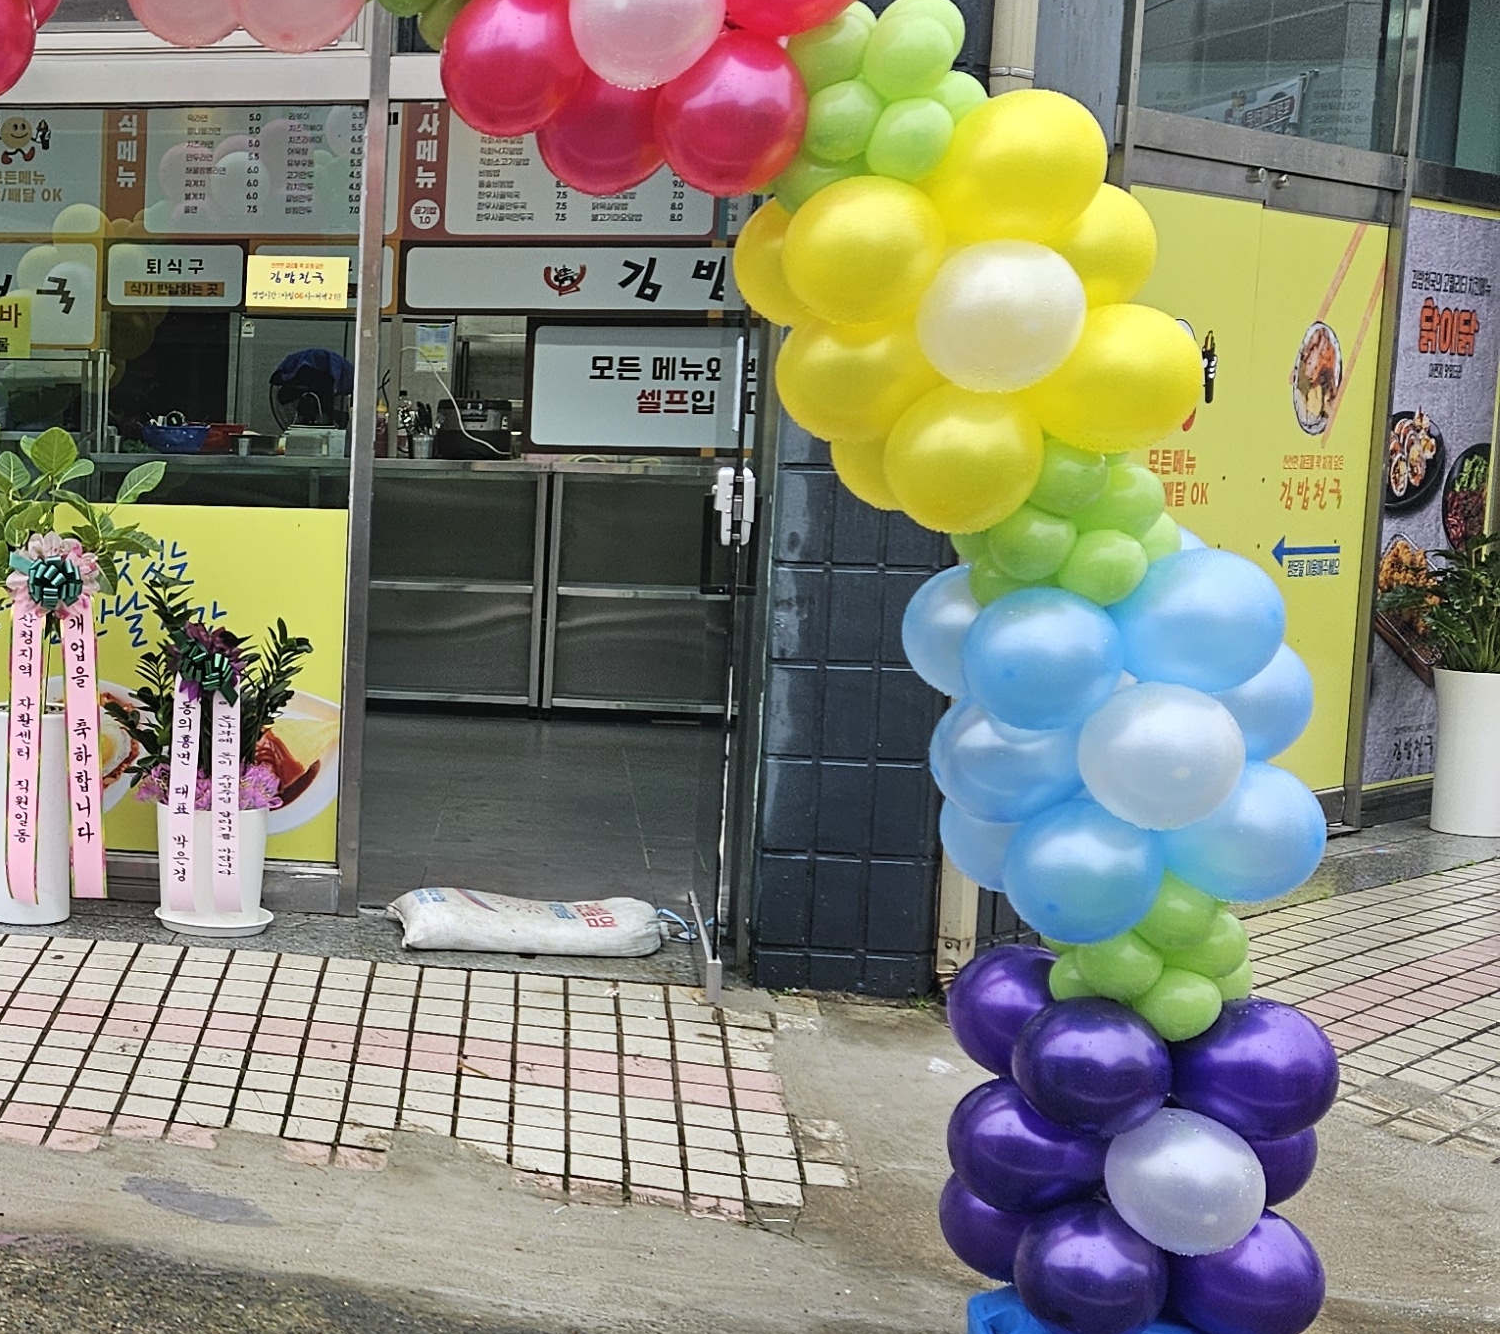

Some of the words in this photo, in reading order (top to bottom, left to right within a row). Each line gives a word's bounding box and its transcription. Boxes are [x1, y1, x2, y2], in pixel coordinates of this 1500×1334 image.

[249, 113, 261, 121] 5.0
[248, 126, 261, 134] 5.0
[248, 139, 260, 147] 5.0
[247, 166, 259, 174] 6.0
[246, 179, 259, 187] 6.0
[672, 180, 685, 188] 9.0
[41, 188, 63, 202] OK
[246, 192, 258, 200] 6.0
[555, 191, 568, 199] 7.5
[672, 191, 684, 199] 7.0
[246, 205, 258, 213] 7.5
[555, 202, 567, 210] 7.5
[670, 202, 684, 210] 8.0
[555, 213, 567, 221] 7.5
[669, 214, 684, 222] 8.0
[146, 258, 204, 275] 퇴식구
[130, 283, 153, 295] 식기
[157, 283, 203, 296] 반납하는
[207, 283, 219, 295] 곳
[589, 356, 643, 381] 모든
[1149, 449, 1197, 476] 모든메뉴
[1191, 481, 1209, 506] OK
[1279, 476, 1342, 511] 김밥천국
[17, 613, 37, 678] 산청지역
[69, 614, 90, 689] 개업을
[73, 718, 95, 844] 축하합니다
[173, 784, 190, 815] 대표
